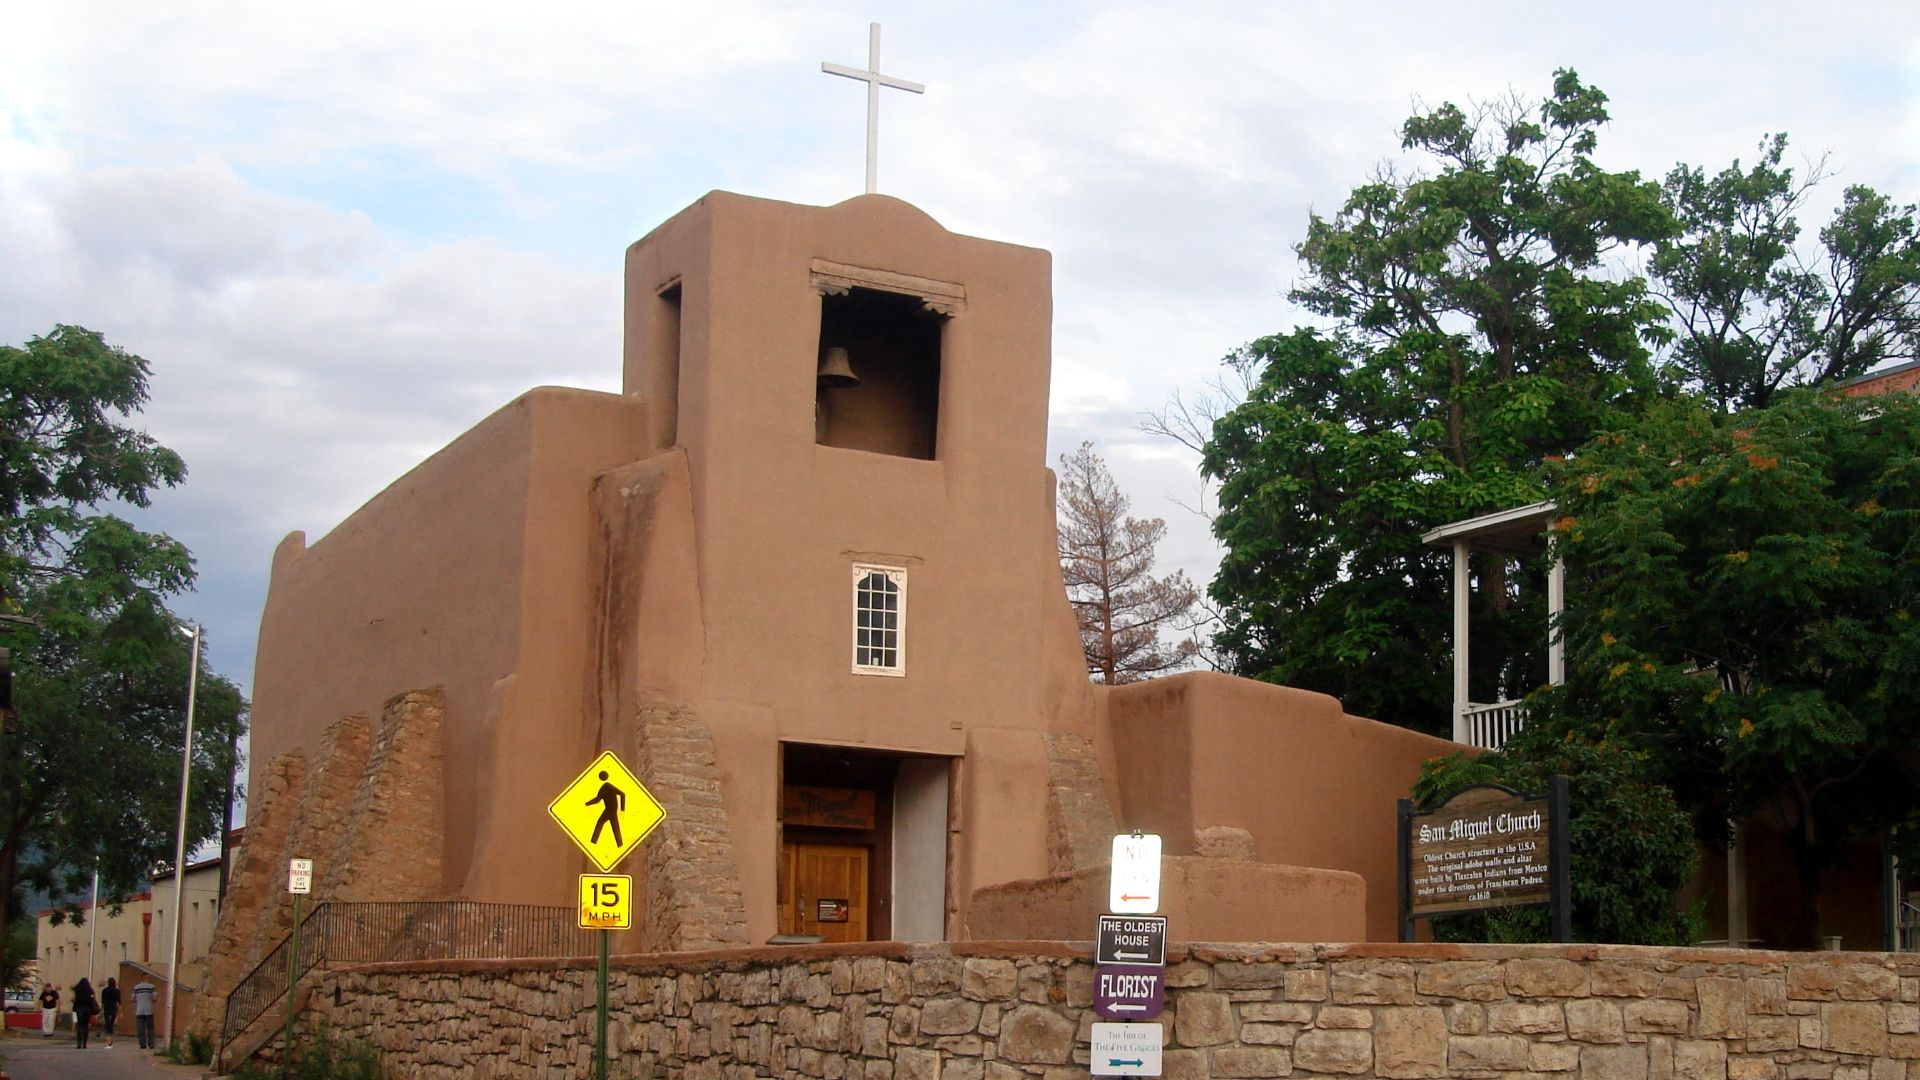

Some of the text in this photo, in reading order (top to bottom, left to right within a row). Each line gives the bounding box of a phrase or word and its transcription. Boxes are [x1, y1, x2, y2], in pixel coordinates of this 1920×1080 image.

[1420, 810, 1540, 843] San Miguel Church
[1424, 854, 1443, 862] Oldest
[1445, 851, 1466, 860] Church
[1468, 848, 1495, 858] structure
[1506, 844, 1516, 853] the
[1428, 854, 1533, 873] The original adobe walls and altar
[1430, 874, 1443, 883] built
[1446, 873, 1452, 883] by
[1454, 870, 1483, 880] Tlaxcalan
[1484, 868, 1506, 877] Indians
[1508, 866, 1523, 875] from
[1525, 865, 1548, 873] Mexico
[591, 882, 620, 907] 15
[1418, 876, 1544, 895] under the direction of Franciscan Padres.
[1103, 921, 1164, 933] THE OLDEST
[1114, 935, 1149, 946] HOUSE
[1100, 975, 1157, 998] FLORIST
[1096, 1042, 1109, 1051] THE
